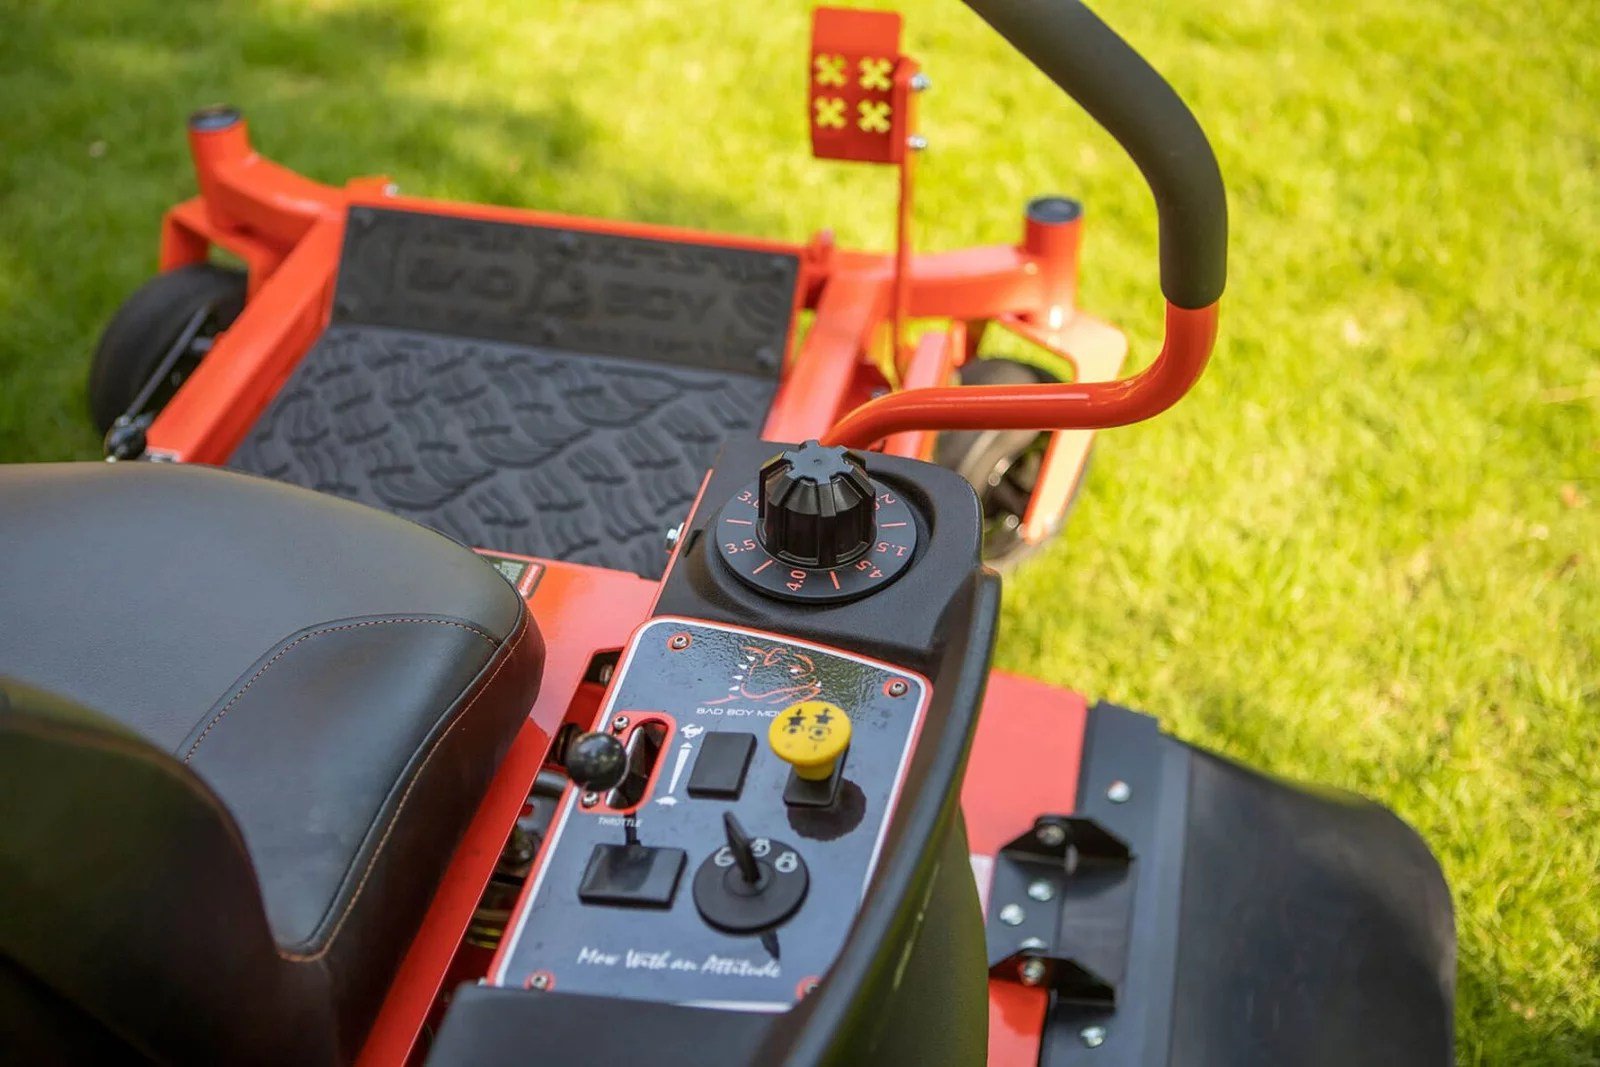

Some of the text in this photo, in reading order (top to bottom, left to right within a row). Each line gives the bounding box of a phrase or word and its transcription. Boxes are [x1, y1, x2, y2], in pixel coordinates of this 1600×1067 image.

[724, 538, 756, 555] 3.5
[876, 541, 907, 557] 1.5
[855, 560, 884, 579] 4.5
[786, 569, 807, 592] 4.0
[696, 707, 724, 716] BAD
[726, 708, 755, 717] BOY
[625, 948, 672, 970] With
[669, 958, 697, 972] an
[701, 954, 781, 979] Attitude
